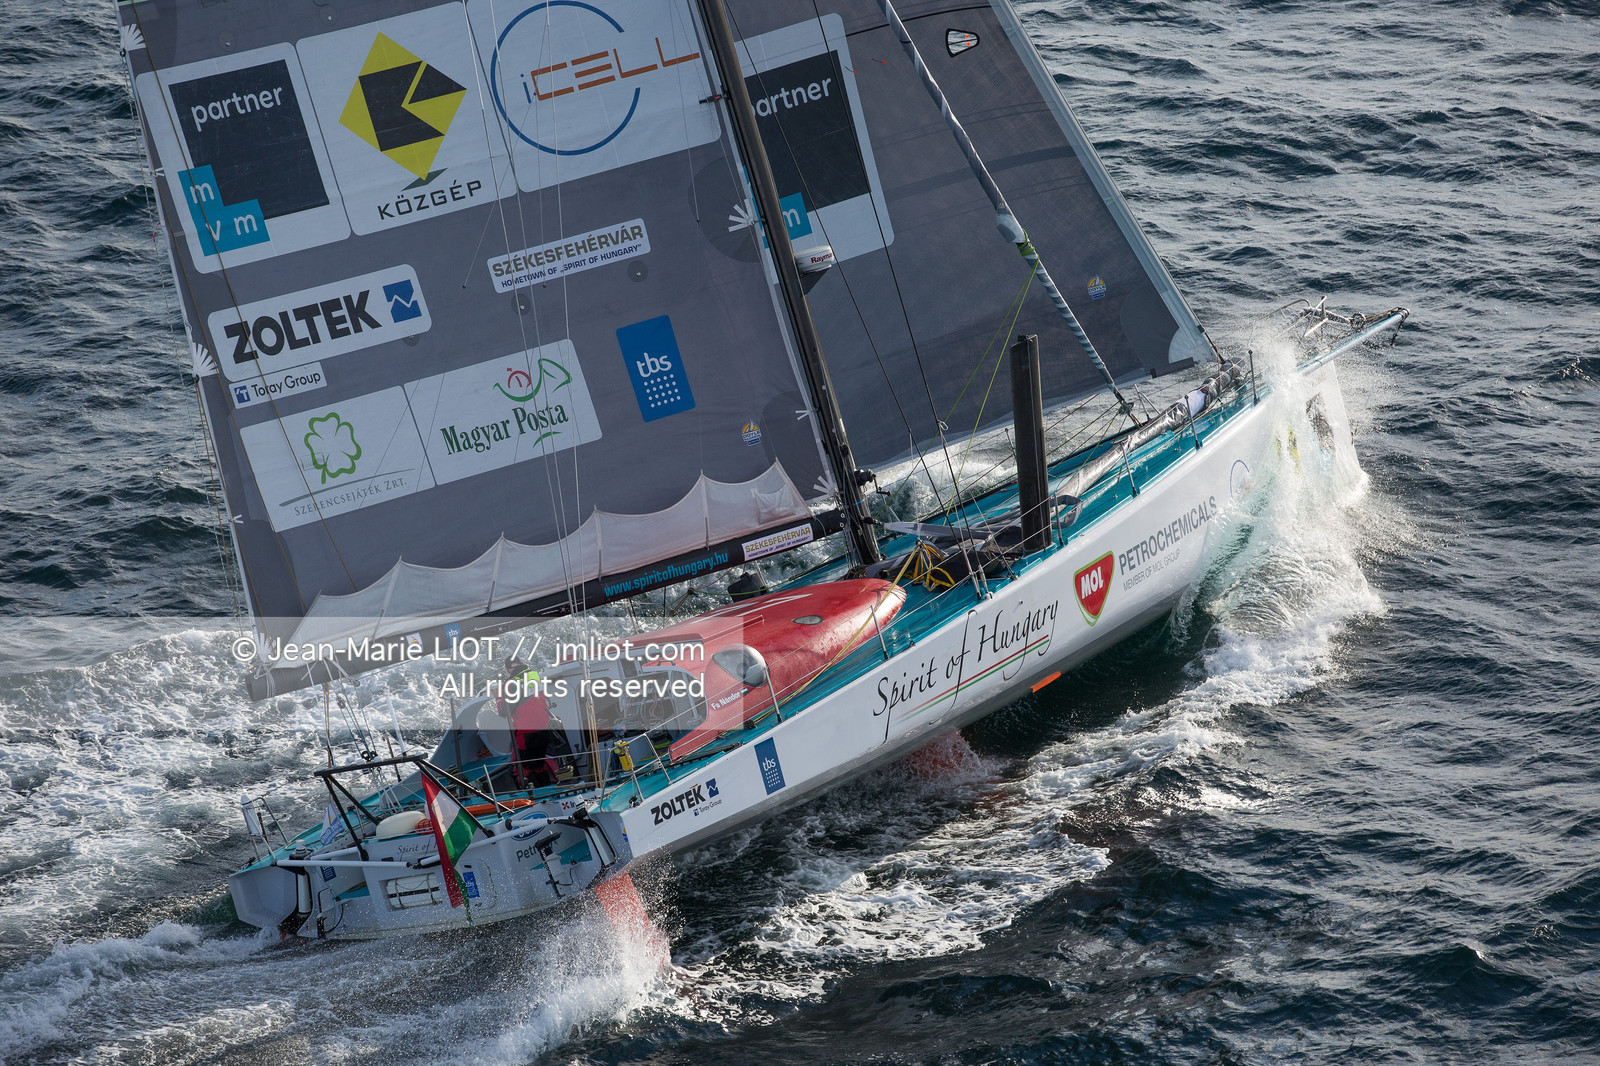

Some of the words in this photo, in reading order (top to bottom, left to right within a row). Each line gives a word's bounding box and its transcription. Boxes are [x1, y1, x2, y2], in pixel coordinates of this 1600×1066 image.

[191, 86, 282, 132] partner
[750, 77, 832, 117] artner
[377, 180, 483, 220] KÖZGÉP
[492, 224, 644, 278] SZÉKESFEHÉRVÁR
[501, 271, 546, 288] HOMETOWN
[547, 266, 558, 276] OF
[588, 255, 599, 265] OF
[223, 289, 382, 365] ZOLTEK
[251, 382, 283, 398] Toray
[284, 372, 321, 389] Group
[636, 352, 672, 379] tbs
[440, 418, 512, 456] Magyar
[511, 403, 569, 436] Posta
[294, 483, 383, 516] SZERENCSEJÁTÉK
[385, 477, 408, 492] ZRT.
[745, 527, 812, 553] SZÉKESFEHÉRVÁR
[1118, 495, 1217, 576] PETROCHEMICALS
[603, 551, 729, 598] www.spiritofhungary.hu
[1080, 566, 1105, 600] MOL
[1122, 571, 1145, 592] MEMBER
[1144, 565, 1153, 580] OF
[1152, 559, 1164, 575] MOL
[1163, 548, 1181, 567] GROUP
[872, 656, 938, 746] Spirit
[929, 609, 978, 726] of
[977, 600, 1059, 682] Hungary
[711, 702, 721, 711] Fa
[762, 757, 777, 772] tbs
[650, 784, 706, 826] ZOLTEK
[699, 804, 710, 814] Toray
[709, 799, 723, 809] Group
[396, 844, 419, 862] Spirit
[421, 834, 435, 858] of
